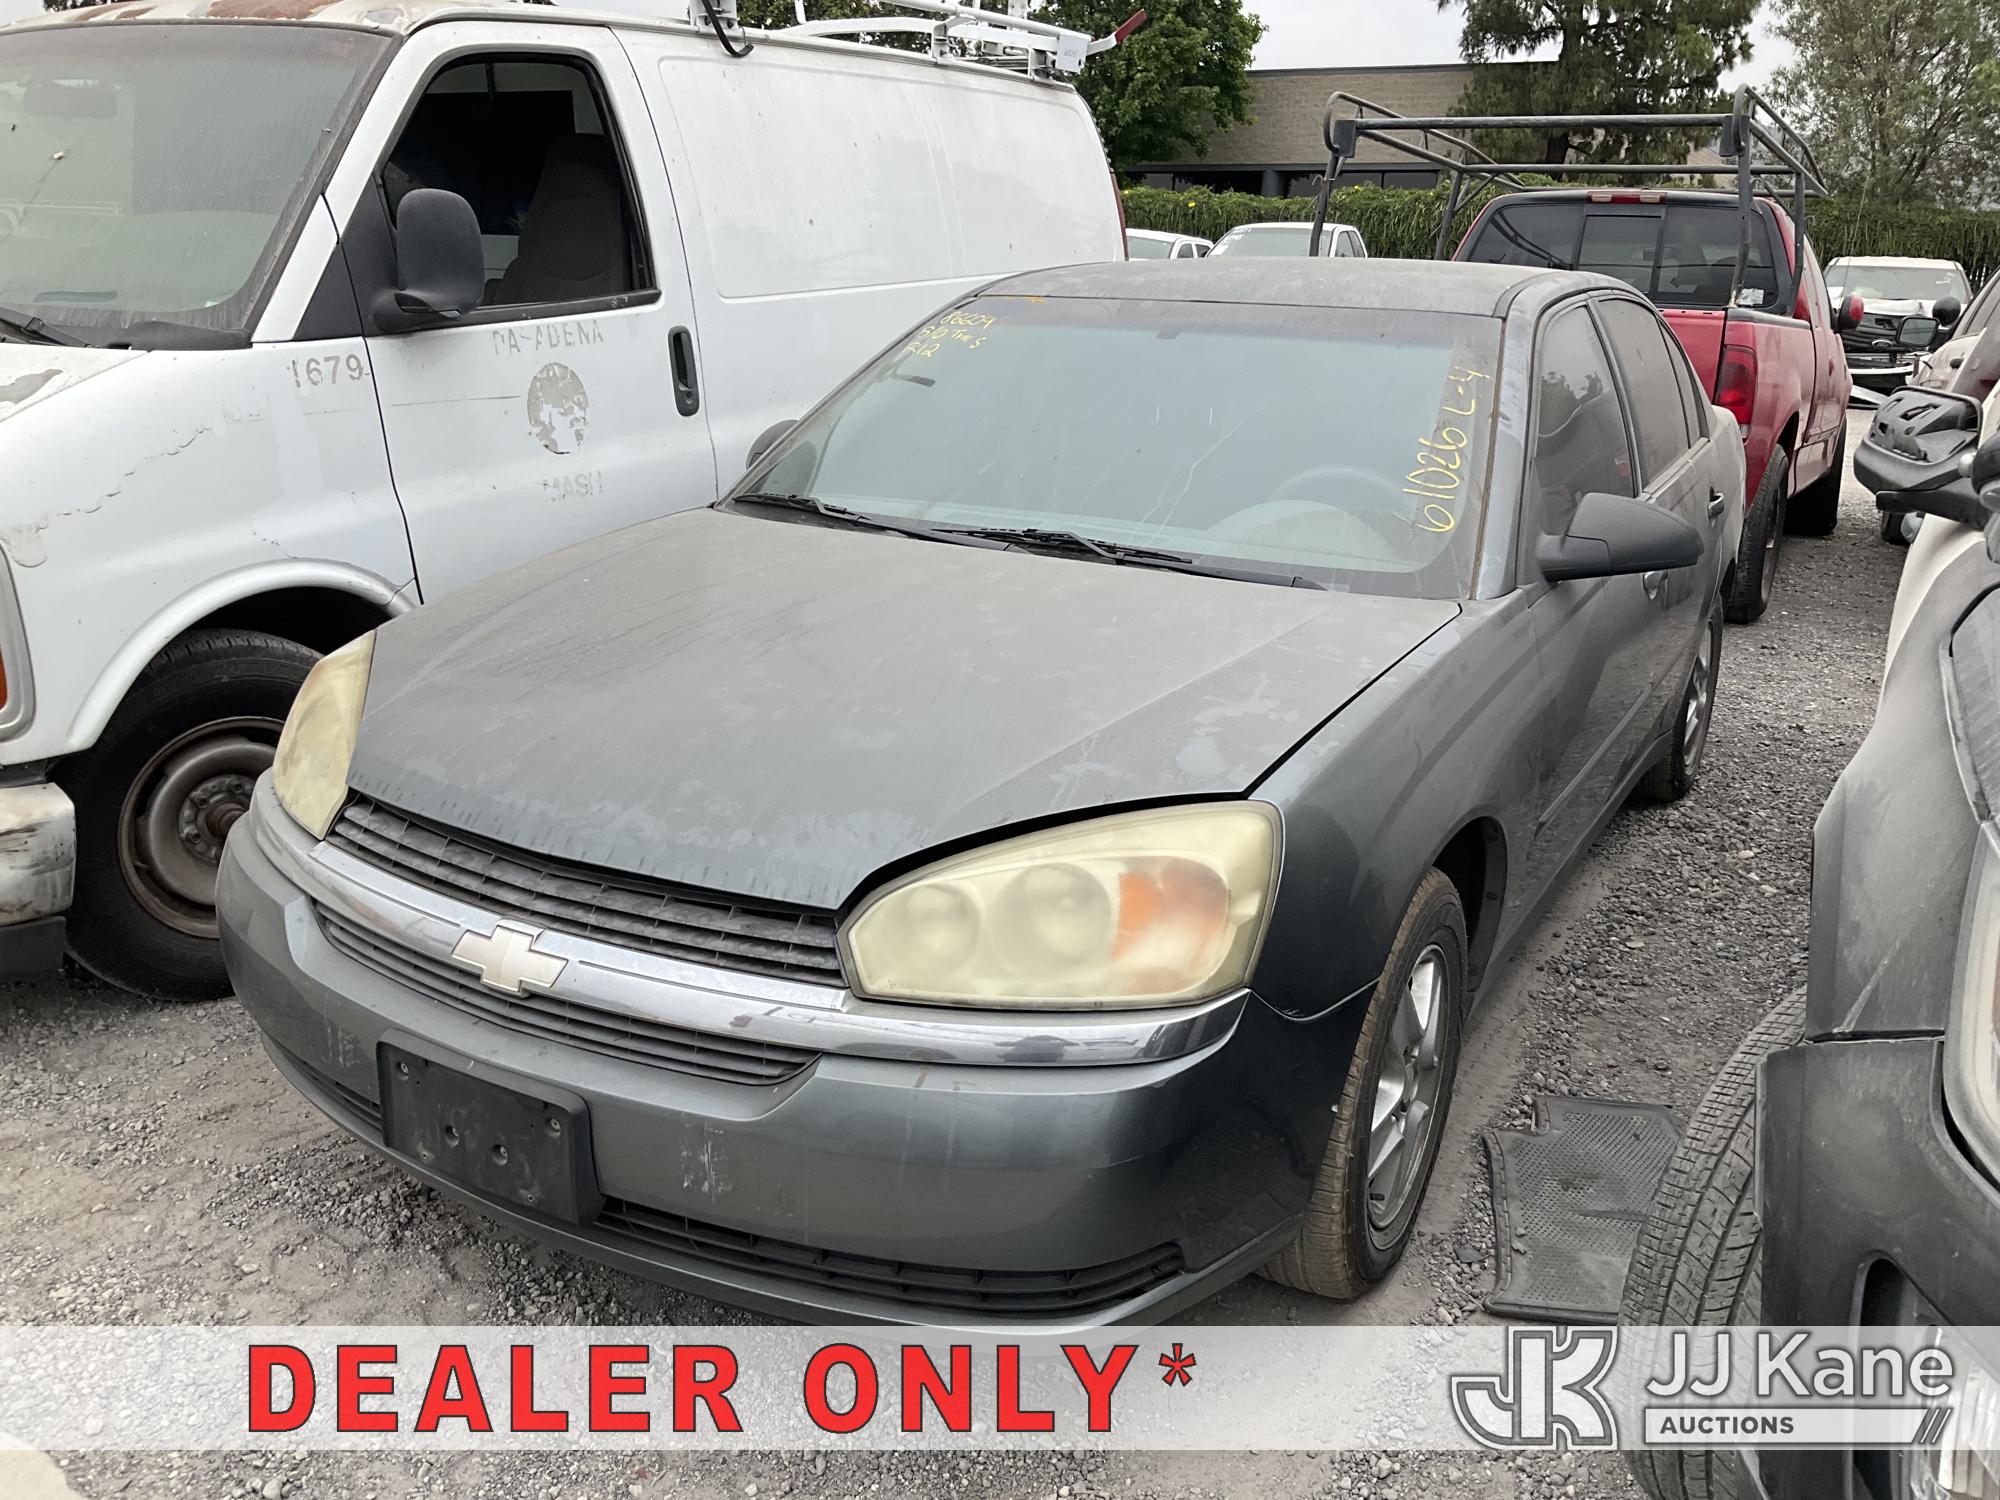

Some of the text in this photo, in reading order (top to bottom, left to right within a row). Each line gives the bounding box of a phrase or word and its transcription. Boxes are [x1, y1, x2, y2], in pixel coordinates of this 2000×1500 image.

[492, 319, 604, 356] PAADENA
[290, 353, 364, 388] 1679
[1397, 427, 1468, 533] 61026
